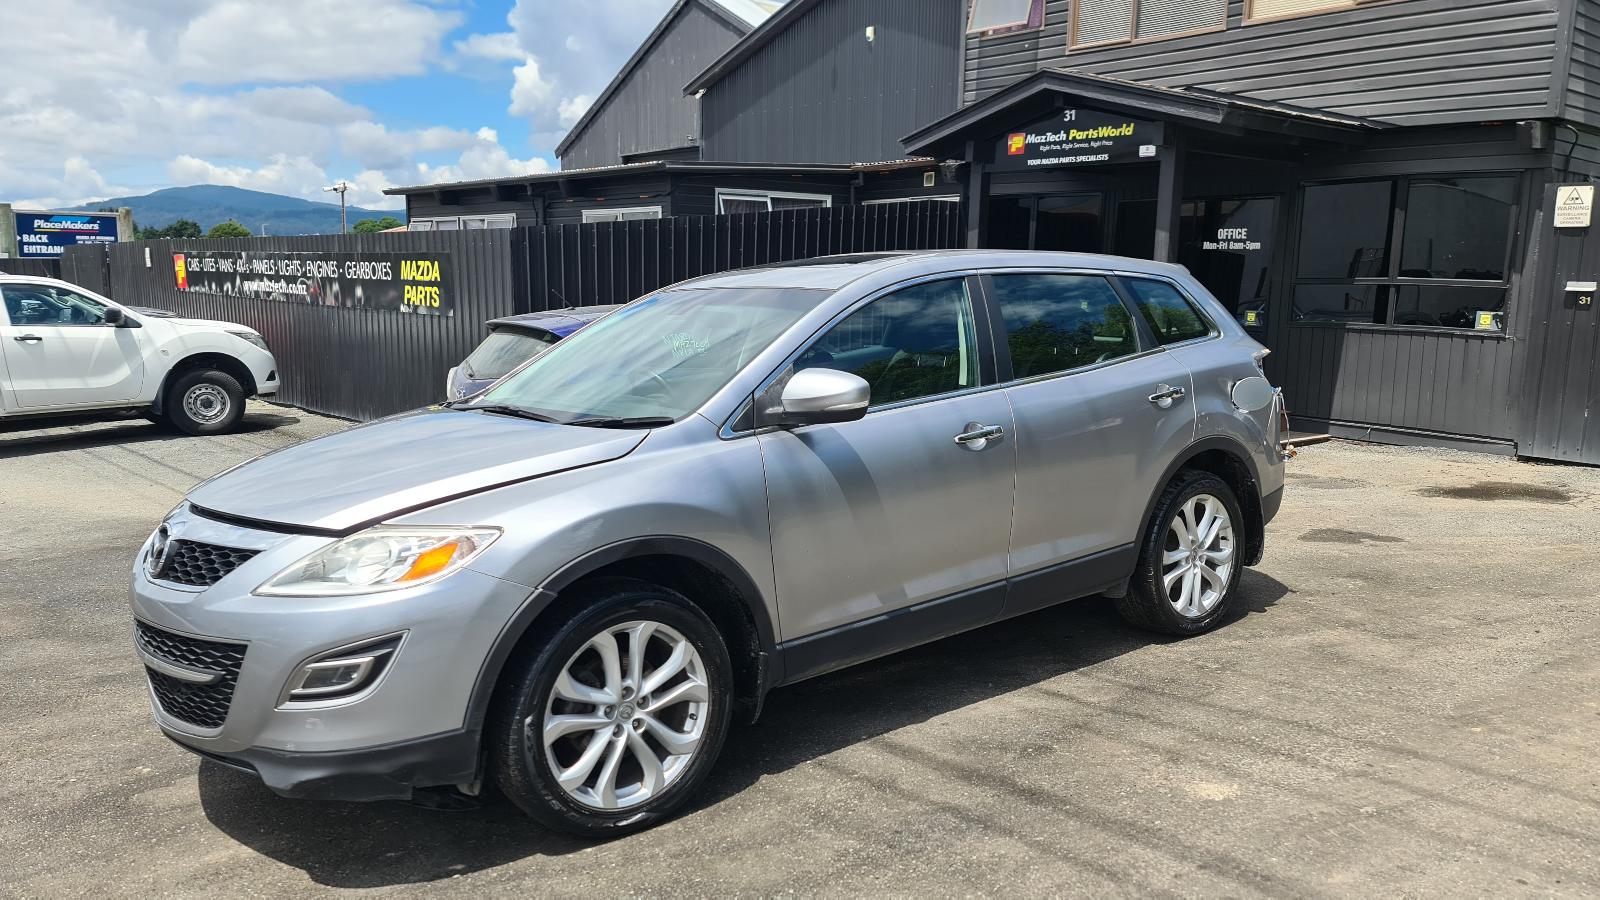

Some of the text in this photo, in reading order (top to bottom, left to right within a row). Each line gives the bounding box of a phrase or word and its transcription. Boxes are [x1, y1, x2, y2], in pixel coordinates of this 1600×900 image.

[1064, 110, 1076, 121] 31
[1025, 123, 1135, 144] MazTech PartsWorld
[1039, 144, 1051, 152] Right
[1062, 142, 1073, 150] Right
[1040, 157, 1059, 165] MAZDA
[1058, 155, 1076, 163] PARTS
[1075, 153, 1109, 163] SPECIALISTS
[34, 219, 100, 229] PlaceMakers
[22, 234, 48, 242] BACK
[1217, 228, 1247, 239] OFFICE
[1202, 241, 1261, 250] Mon-Fri 8am-5pm
[187, 257, 200, 271] CARS
[202, 257, 215, 272] UTES
[218, 258, 234, 273] VANS
[252, 259, 275, 275] PANELS
[278, 260, 301, 276] LIGHTS
[306, 260, 338, 278] ENGINES
[344, 261, 392, 280] GEARBOXES
[400, 260, 441, 281] MAZDA
[403, 285, 440, 308] PARTS
[1578, 296, 1591, 304] 31
